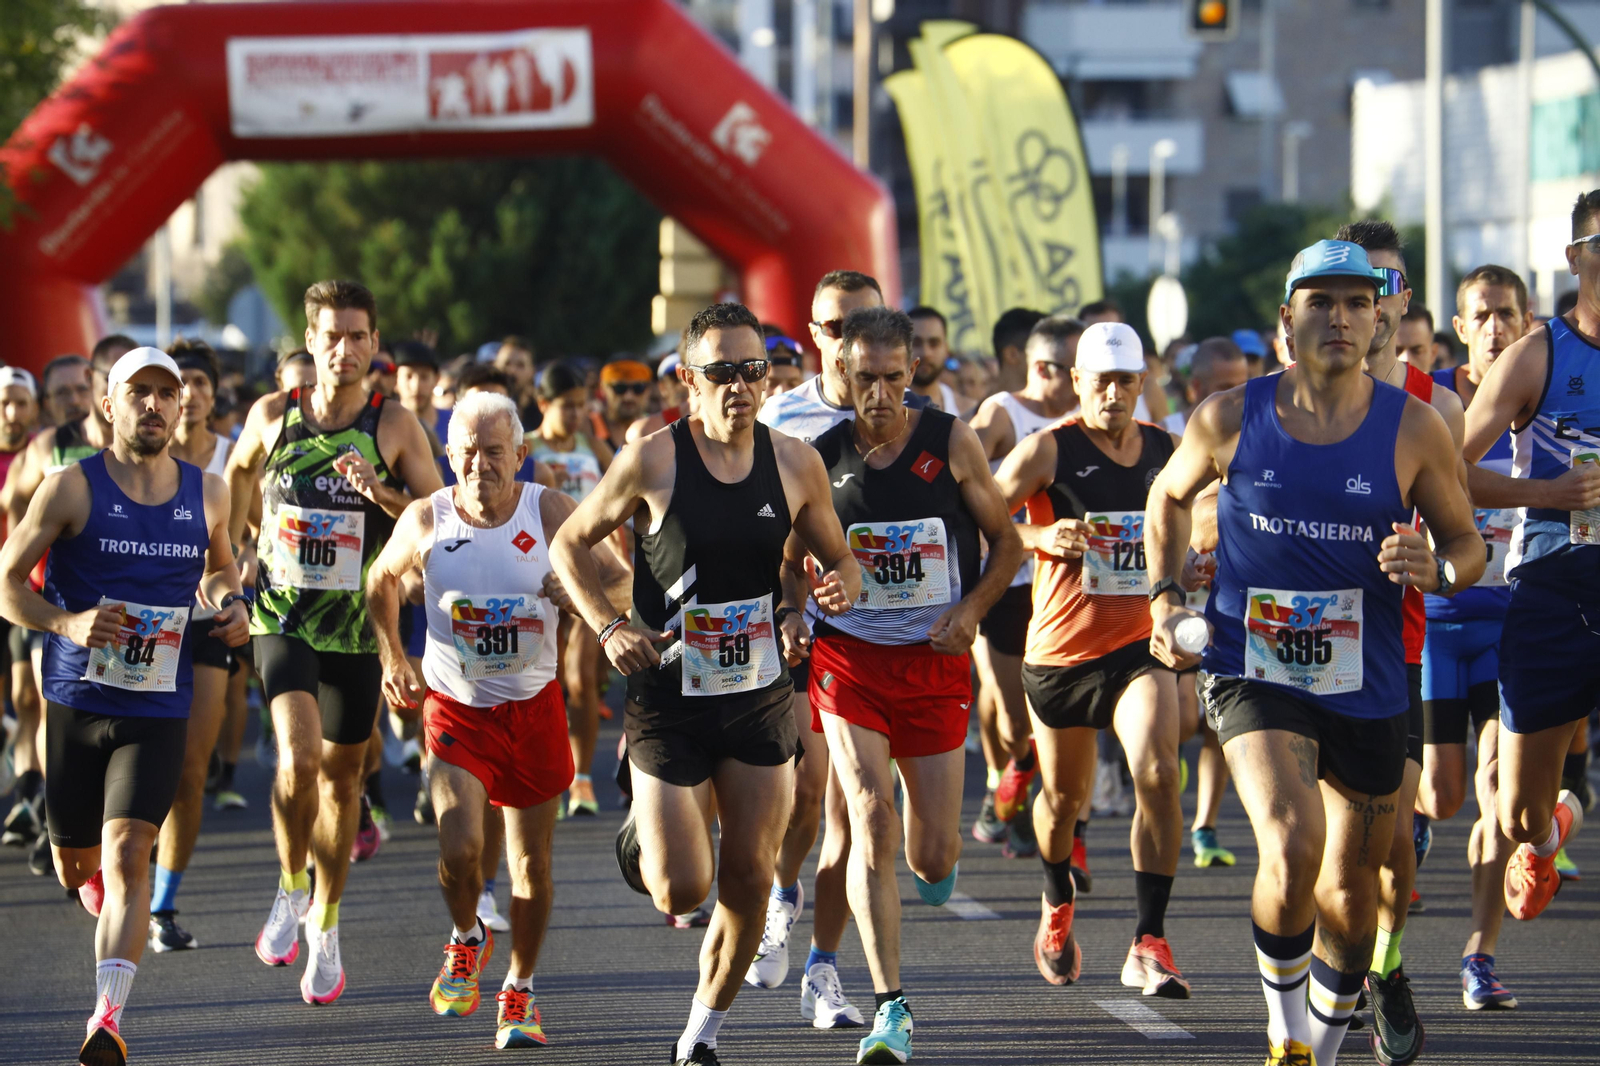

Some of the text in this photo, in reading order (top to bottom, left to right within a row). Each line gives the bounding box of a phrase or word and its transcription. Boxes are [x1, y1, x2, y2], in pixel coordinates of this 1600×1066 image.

[331, 495, 364, 505] TRAIL
[1249, 512, 1374, 542] TROTASIERRA
[99, 538, 199, 558] TROTASIERRA
[298, 537, 336, 567] 106
[1112, 541, 1147, 571] 126
[874, 552, 925, 584] 394
[124, 635, 157, 667] 84
[476, 625, 519, 656] 391
[719, 633, 750, 668] 59
[1276, 628, 1332, 667] 395
